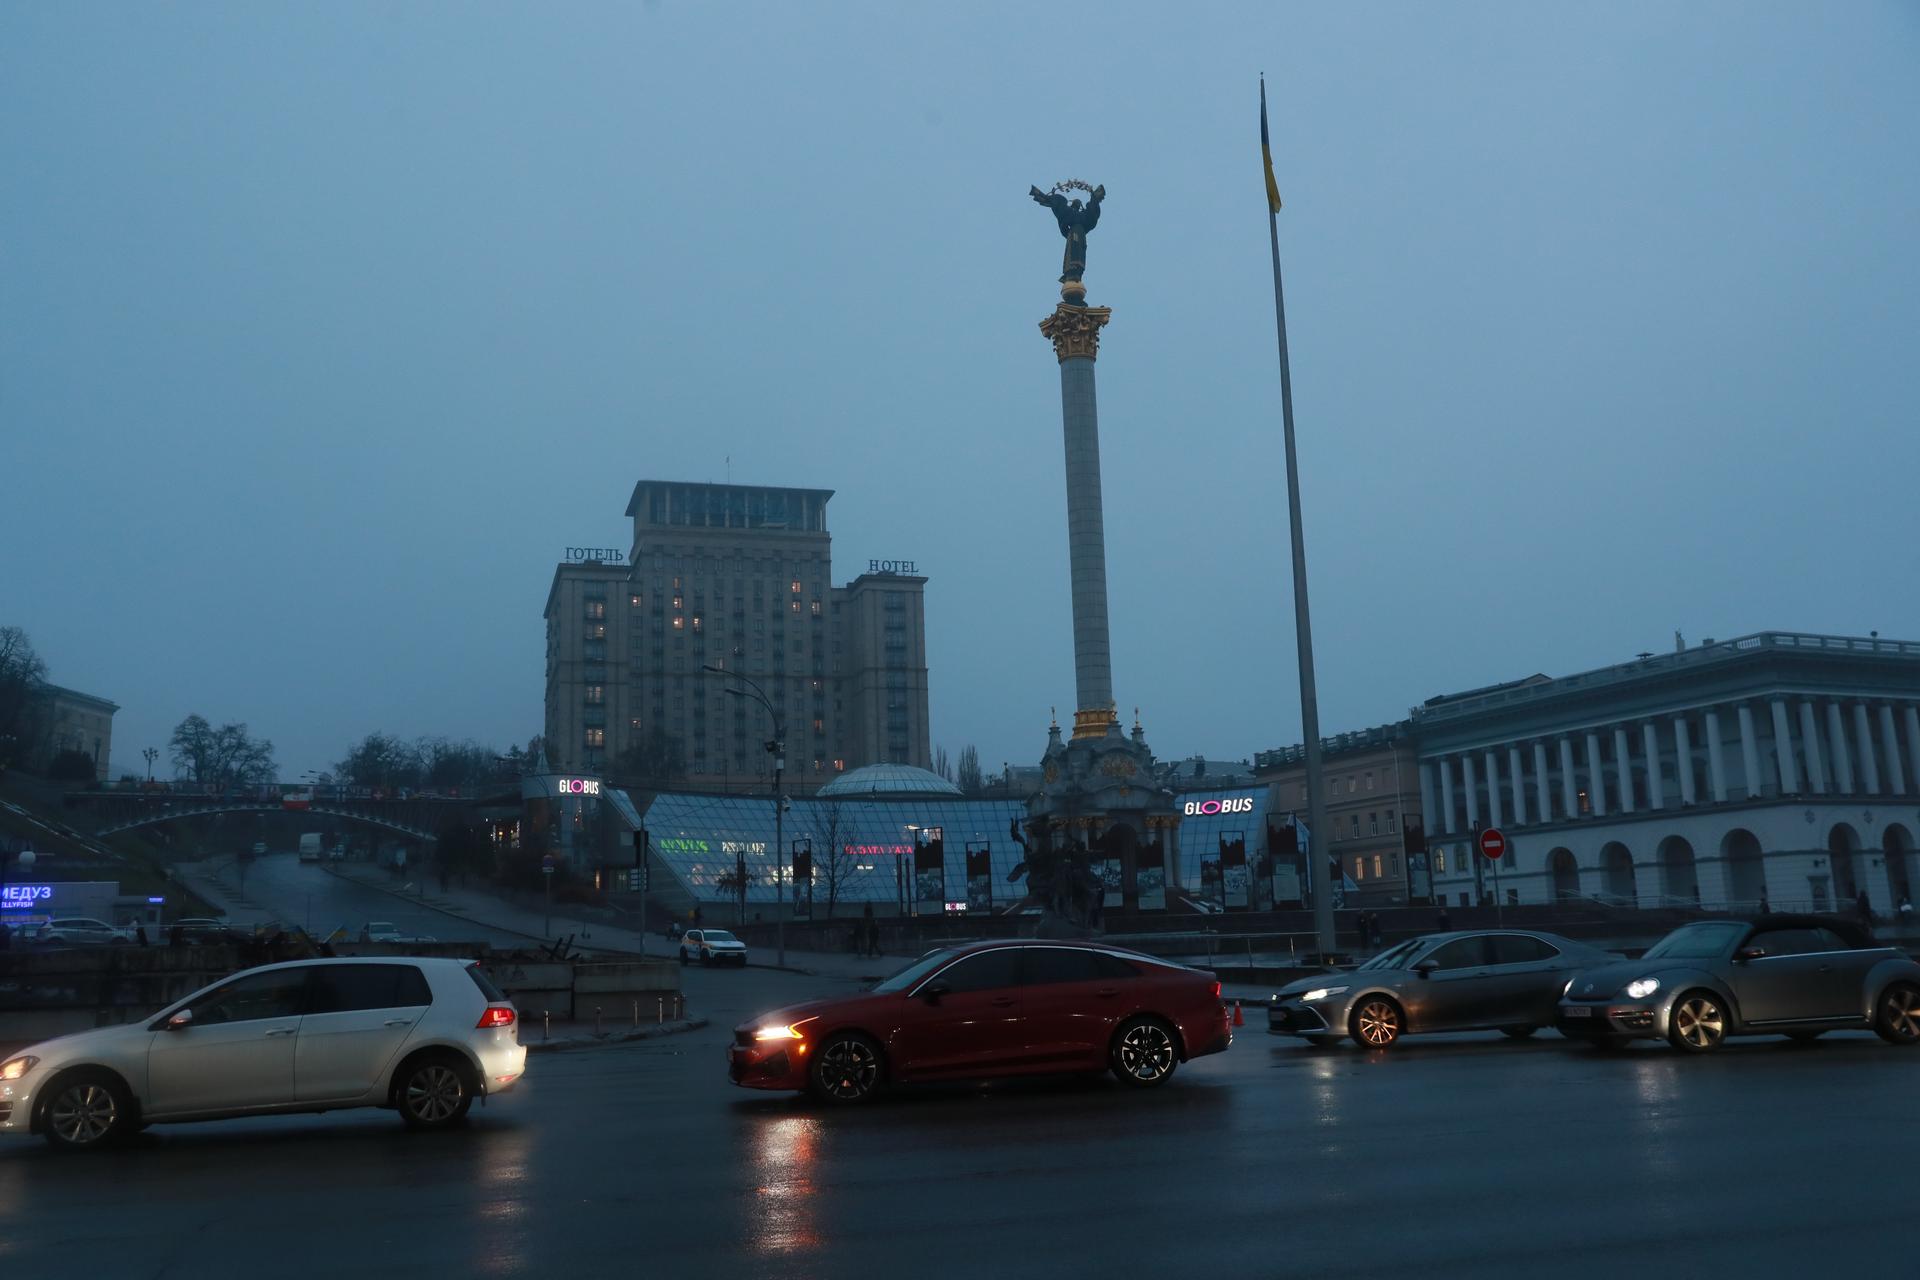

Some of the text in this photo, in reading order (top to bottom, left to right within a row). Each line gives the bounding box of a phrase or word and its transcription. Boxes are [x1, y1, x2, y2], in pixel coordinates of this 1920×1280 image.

[566, 547, 623, 561] ГОТЕЛЬ
[869, 559, 919, 573] HOTEL
[559, 779, 599, 795] GLOBUS
[1184, 797, 1253, 816] GLOBUS
[944, 902, 967, 911] GLOBUS
